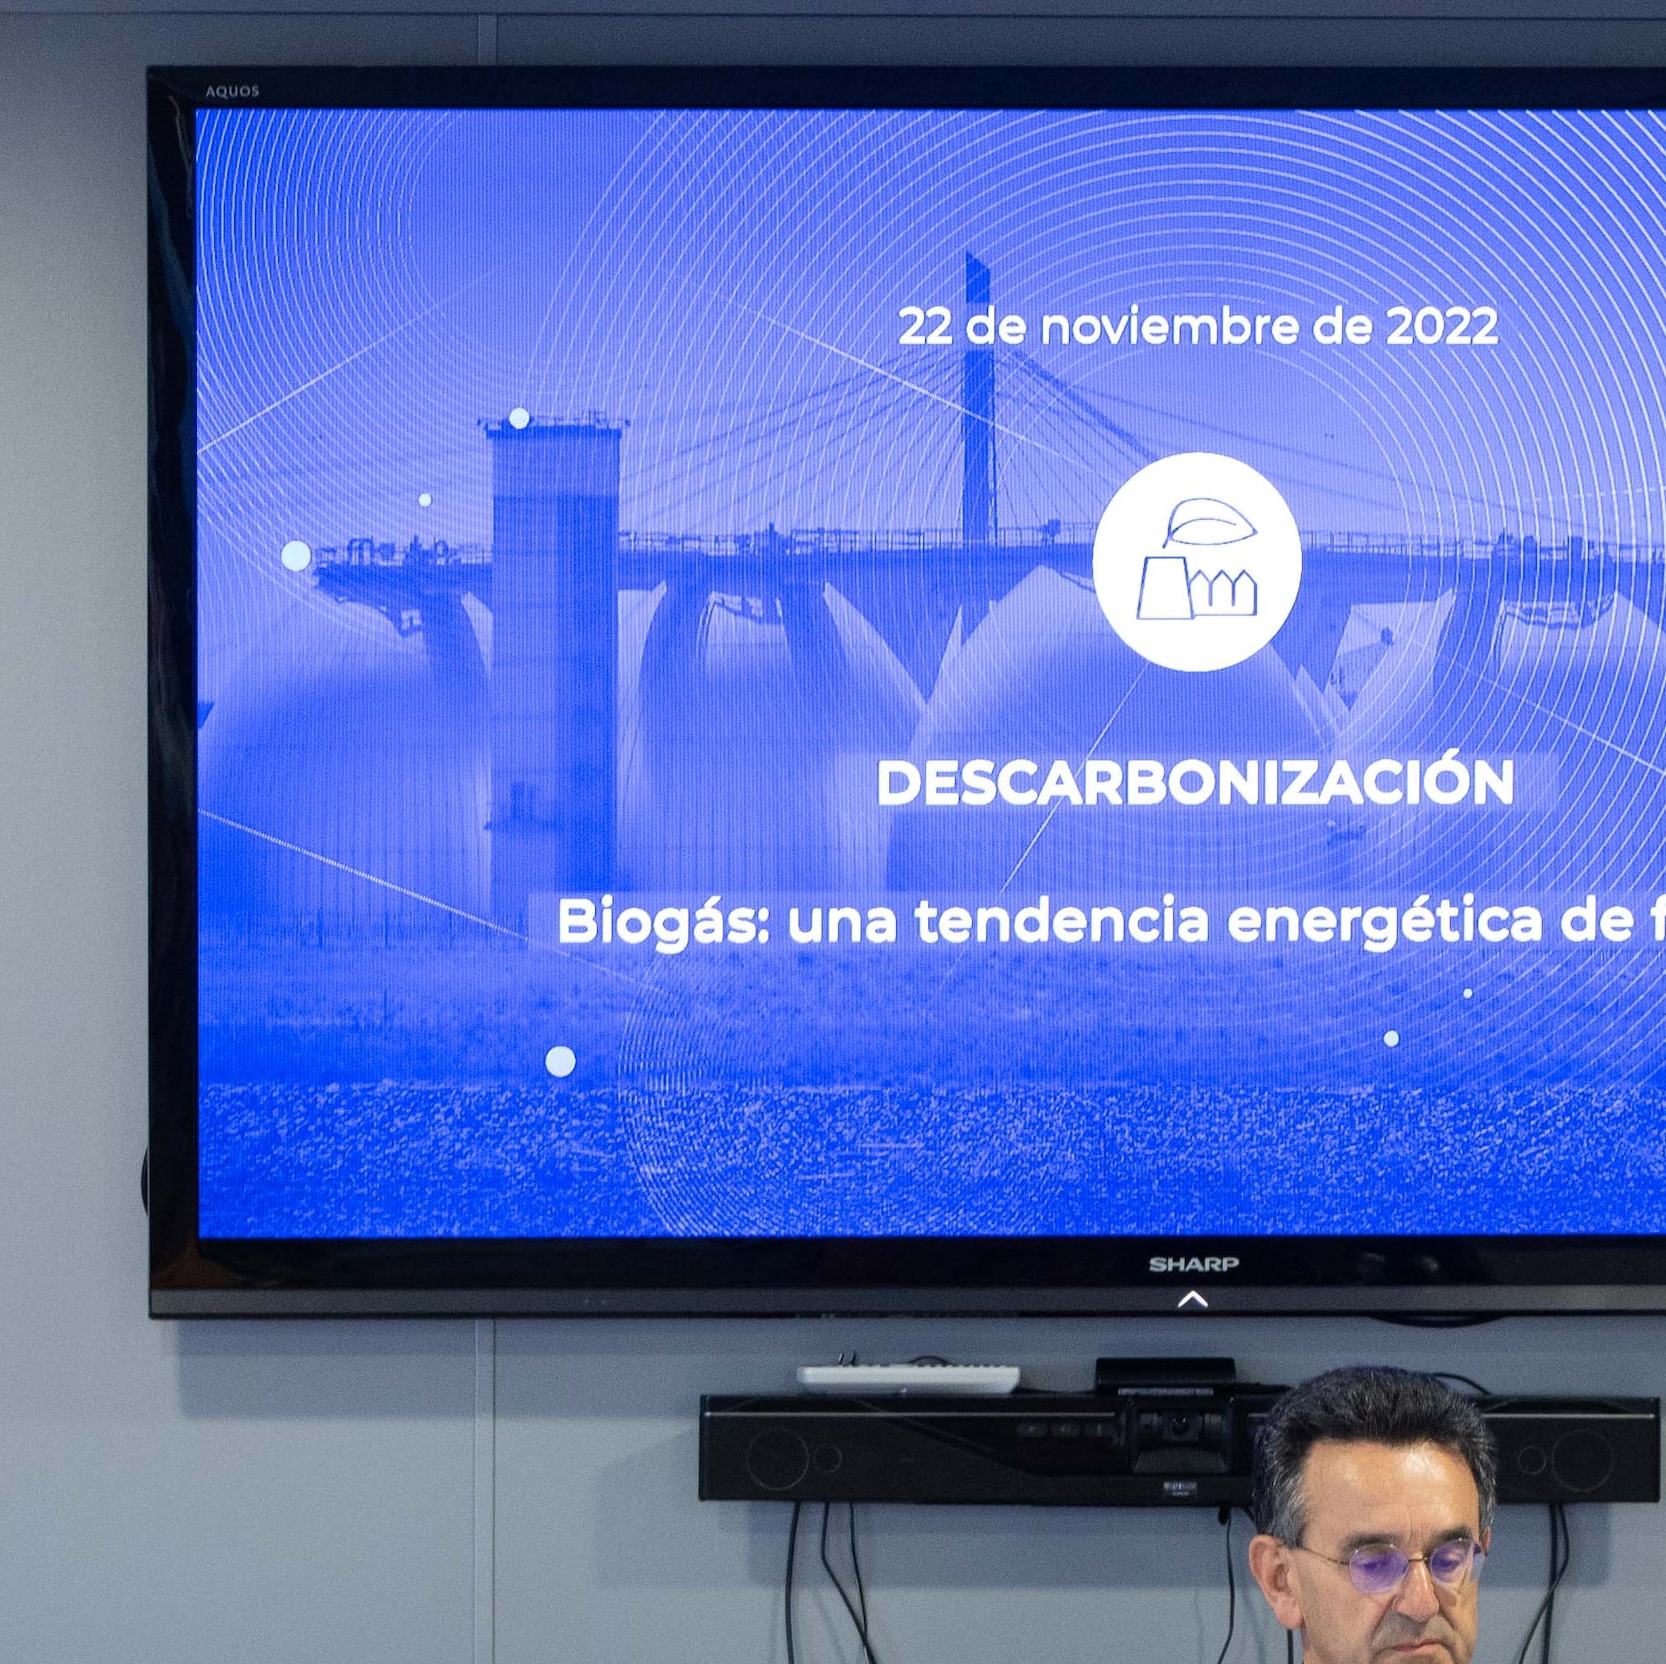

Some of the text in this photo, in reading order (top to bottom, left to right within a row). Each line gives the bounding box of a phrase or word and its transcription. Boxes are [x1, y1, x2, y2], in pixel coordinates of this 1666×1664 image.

[205, 85, 260, 99] AQUOS
[898, 304, 1500, 346] 22 de noviembre de 2022
[877, 748, 1514, 806] DESCARBONIZACIÓN
[558, 894, 769, 955] Biogás:
[788, 904, 897, 944] una
[915, 893, 1209, 943] tendencia
[1227, 893, 1542, 954] energética
[1560, 894, 1633, 944] de
[1149, 1256, 1240, 1273] SHARP
